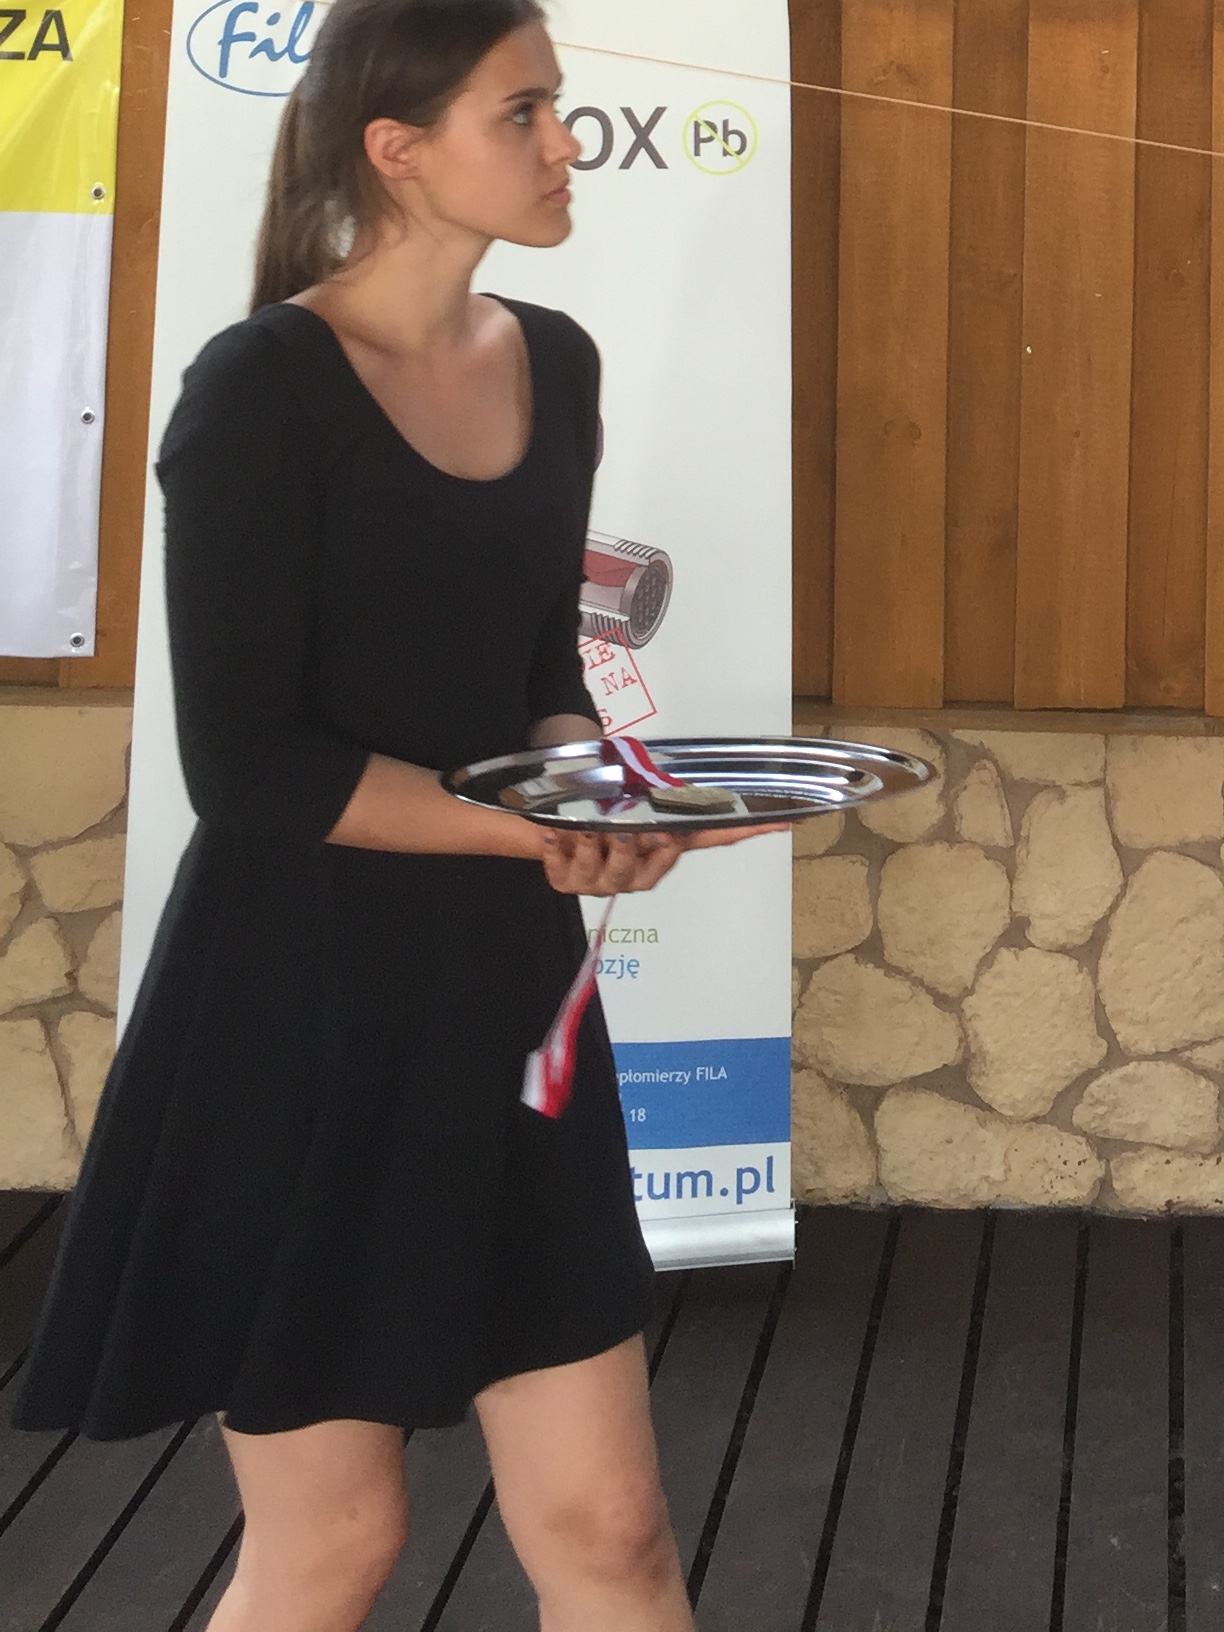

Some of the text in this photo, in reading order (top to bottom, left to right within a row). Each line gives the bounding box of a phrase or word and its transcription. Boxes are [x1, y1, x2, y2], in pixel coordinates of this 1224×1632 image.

[0, 9, 73, 62] ZA
[563, 106, 747, 171] OX Pb
[695, 1066, 728, 1081] FILA
[629, 1107, 647, 1122] 18
